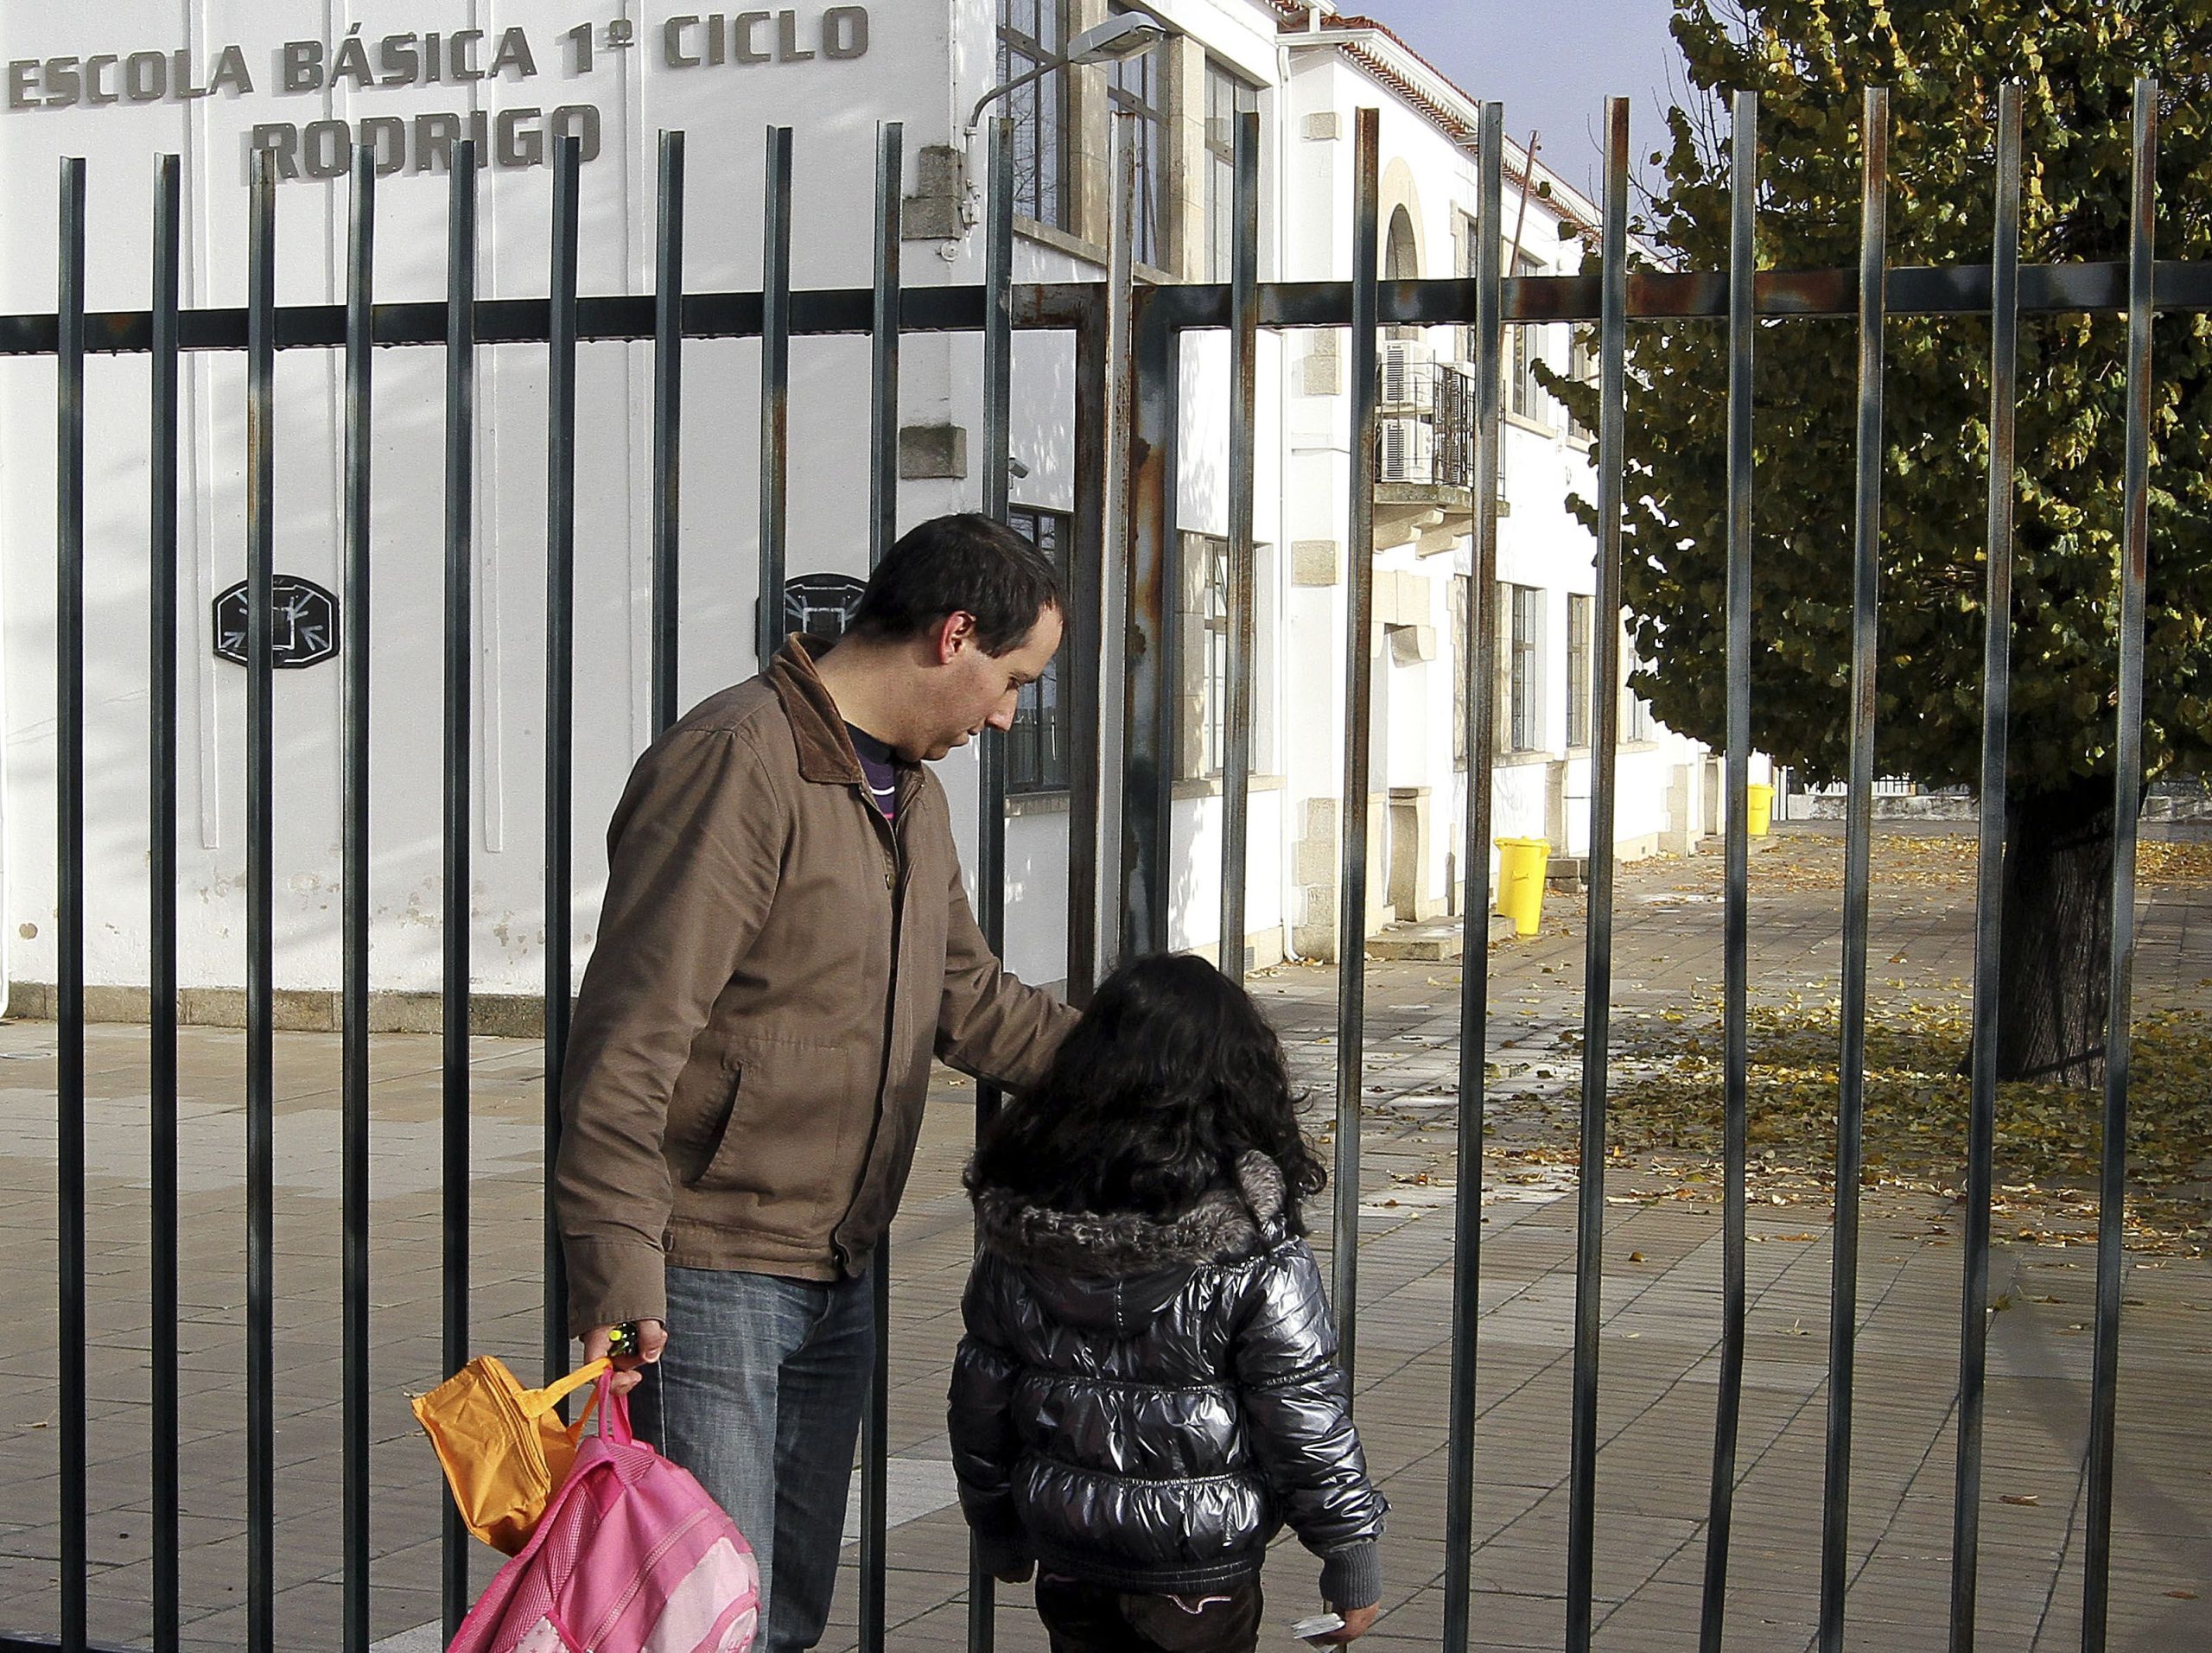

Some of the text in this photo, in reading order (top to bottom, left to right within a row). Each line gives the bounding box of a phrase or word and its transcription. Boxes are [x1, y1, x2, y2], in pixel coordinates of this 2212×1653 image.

[9, 46, 254, 108] ESCOLA
[283, 22, 537, 92] BÁSICA
[664, 6, 869, 68] CICLO
[252, 104, 601, 179] RODRIGO
